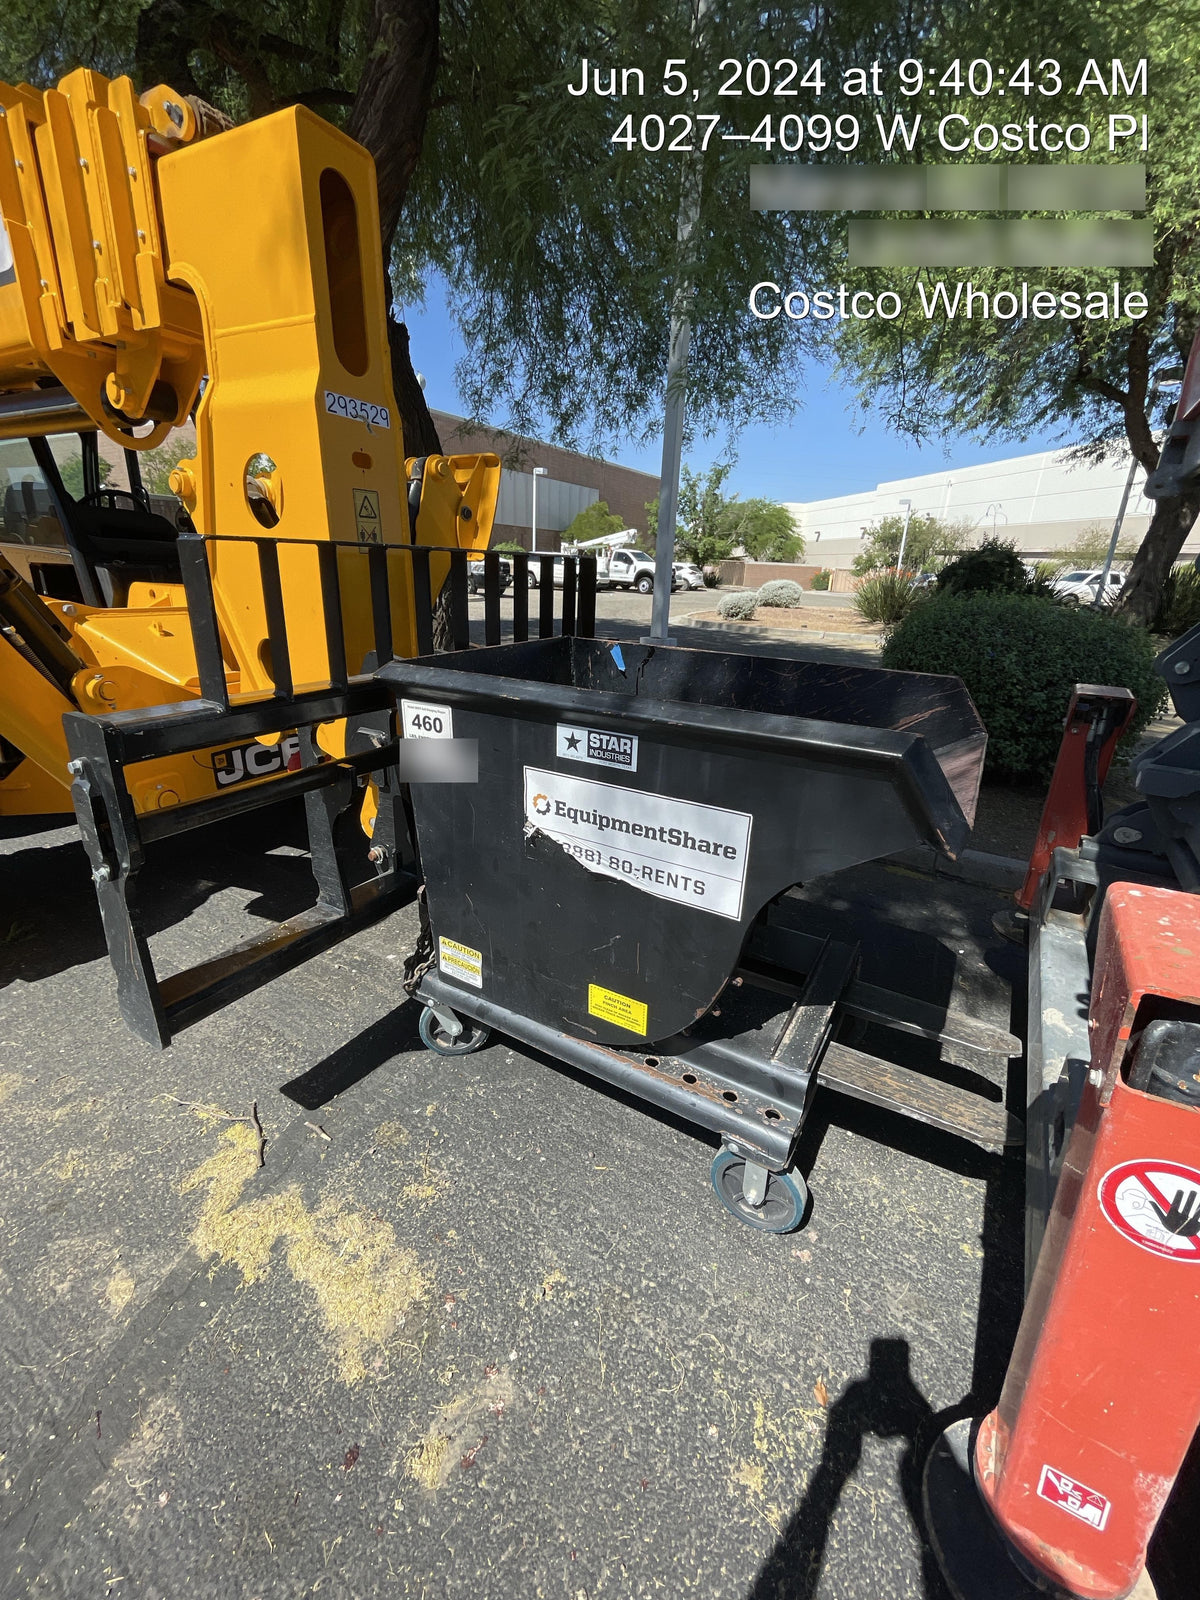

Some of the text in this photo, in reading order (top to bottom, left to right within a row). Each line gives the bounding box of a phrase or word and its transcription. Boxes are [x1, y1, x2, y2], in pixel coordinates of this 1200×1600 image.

[326, 392, 390, 428] 293529
[814, 531, 821, 543] 7
[860, 527, 867, 540] 7
[411, 713, 444, 734] 460
[589, 733, 632, 754] STAR
[589, 748, 632, 763] INDUSTRIES
[555, 799, 738, 861] EquipmentShare
[608, 856, 706, 896] 80-RENTS
[448, 941, 480, 960] CAUTION
[603, 995, 631, 1009] CAUTION
